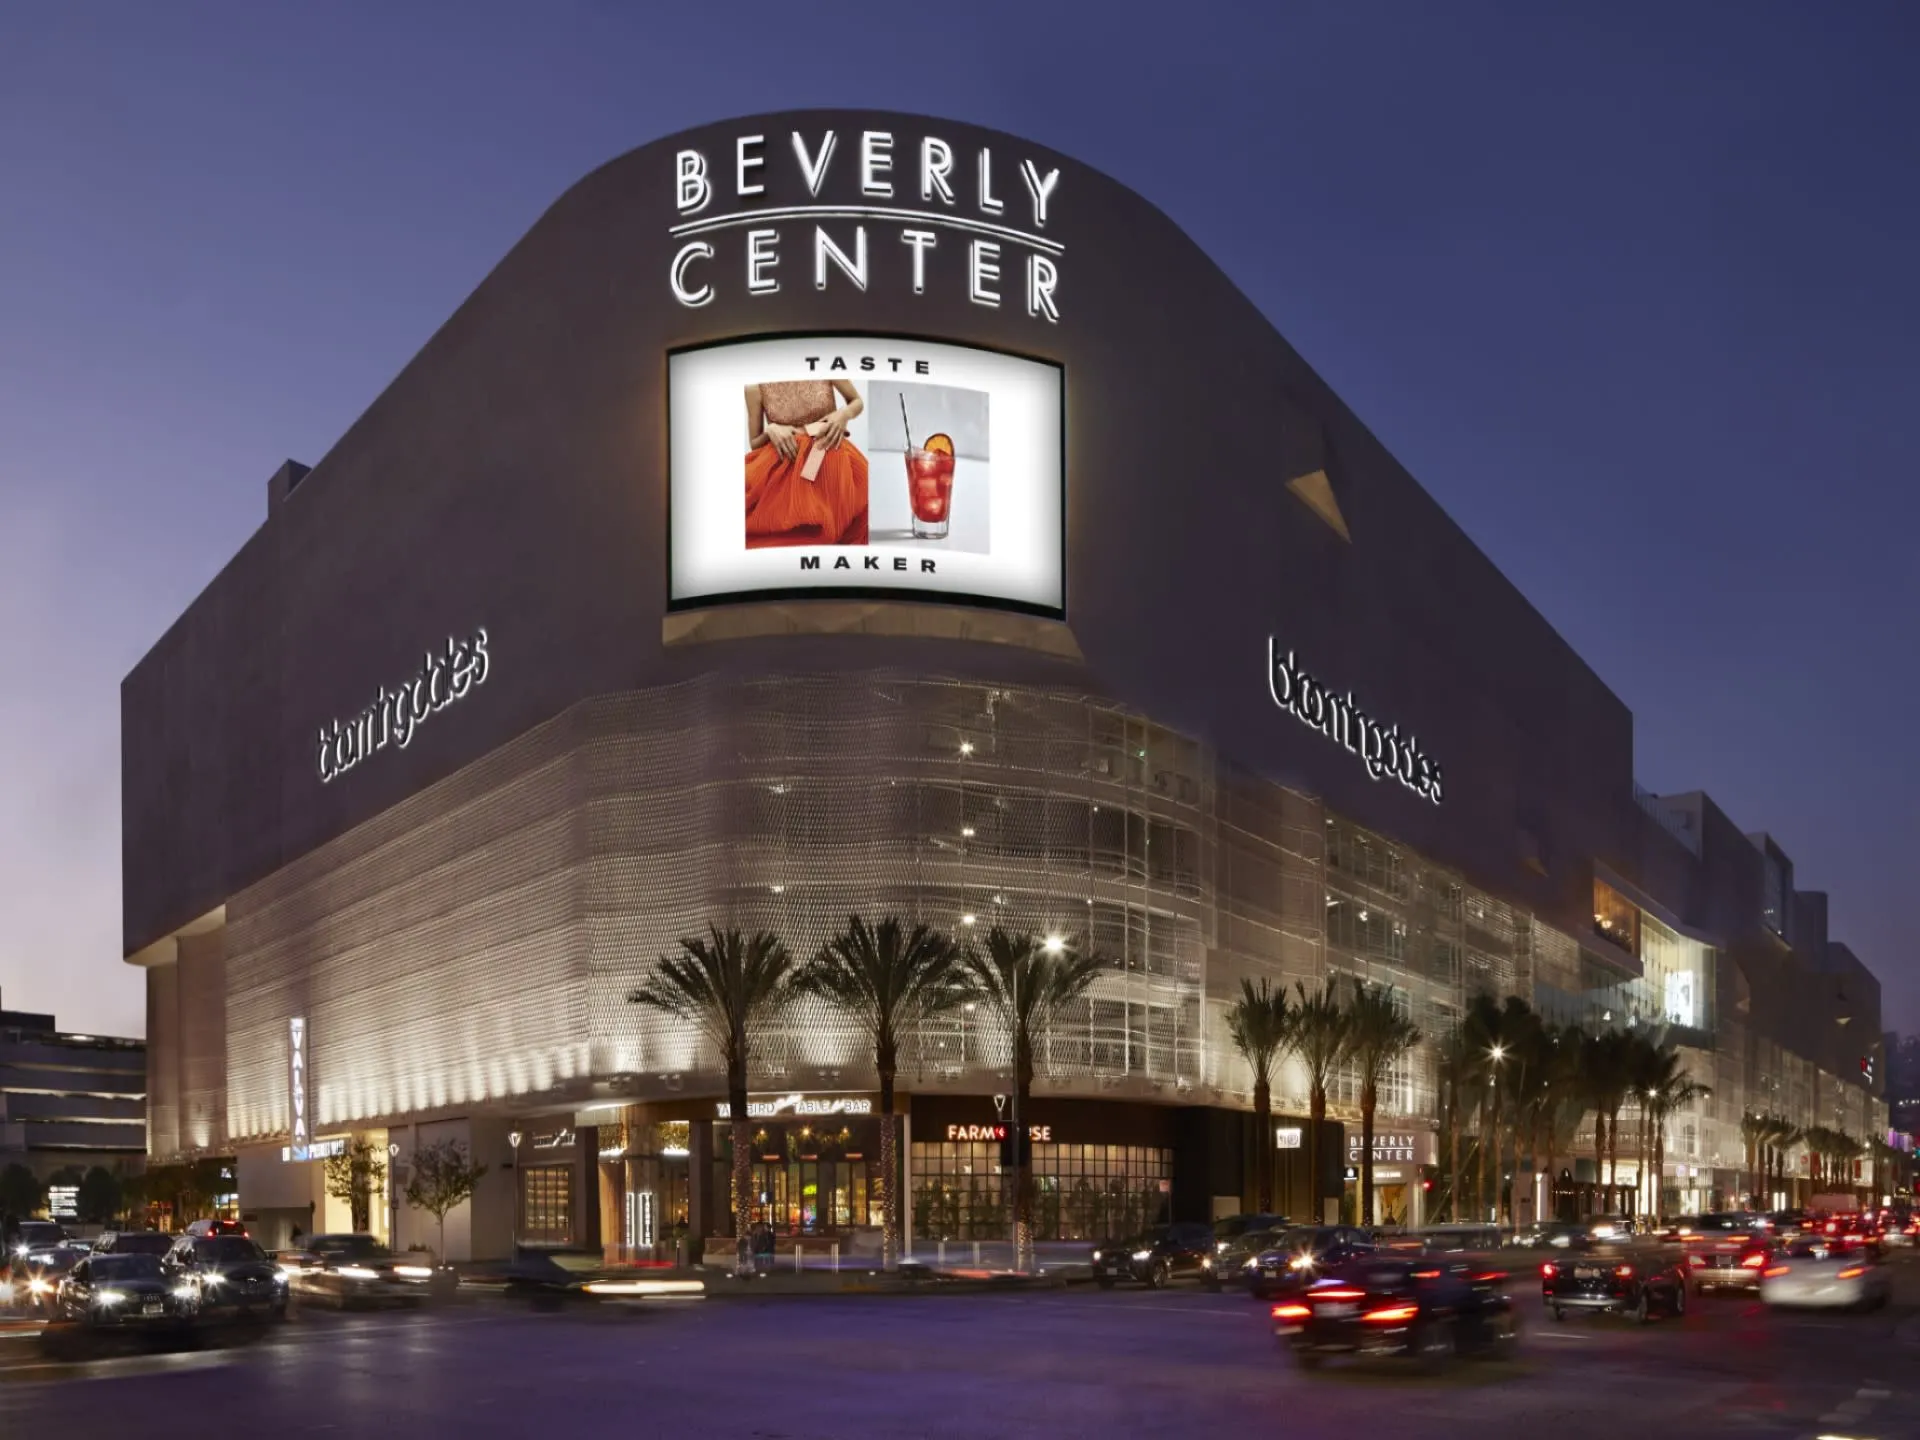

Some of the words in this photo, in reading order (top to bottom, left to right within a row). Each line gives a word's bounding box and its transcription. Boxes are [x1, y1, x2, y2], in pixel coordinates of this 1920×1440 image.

[676, 130, 1060, 227] BEVERLY
[670, 225, 1060, 323] CENTER
[805, 356, 930, 375] TASTE
[800, 556, 937, 574] MAKER
[716, 1102, 776, 1118] YABIRD
[793, 1099, 830, 1115] TABLE
[844, 1099, 872, 1114] BAR
[947, 1124, 1052, 1141] FARMSE
[1349, 1150, 1413, 1162] CNTER
